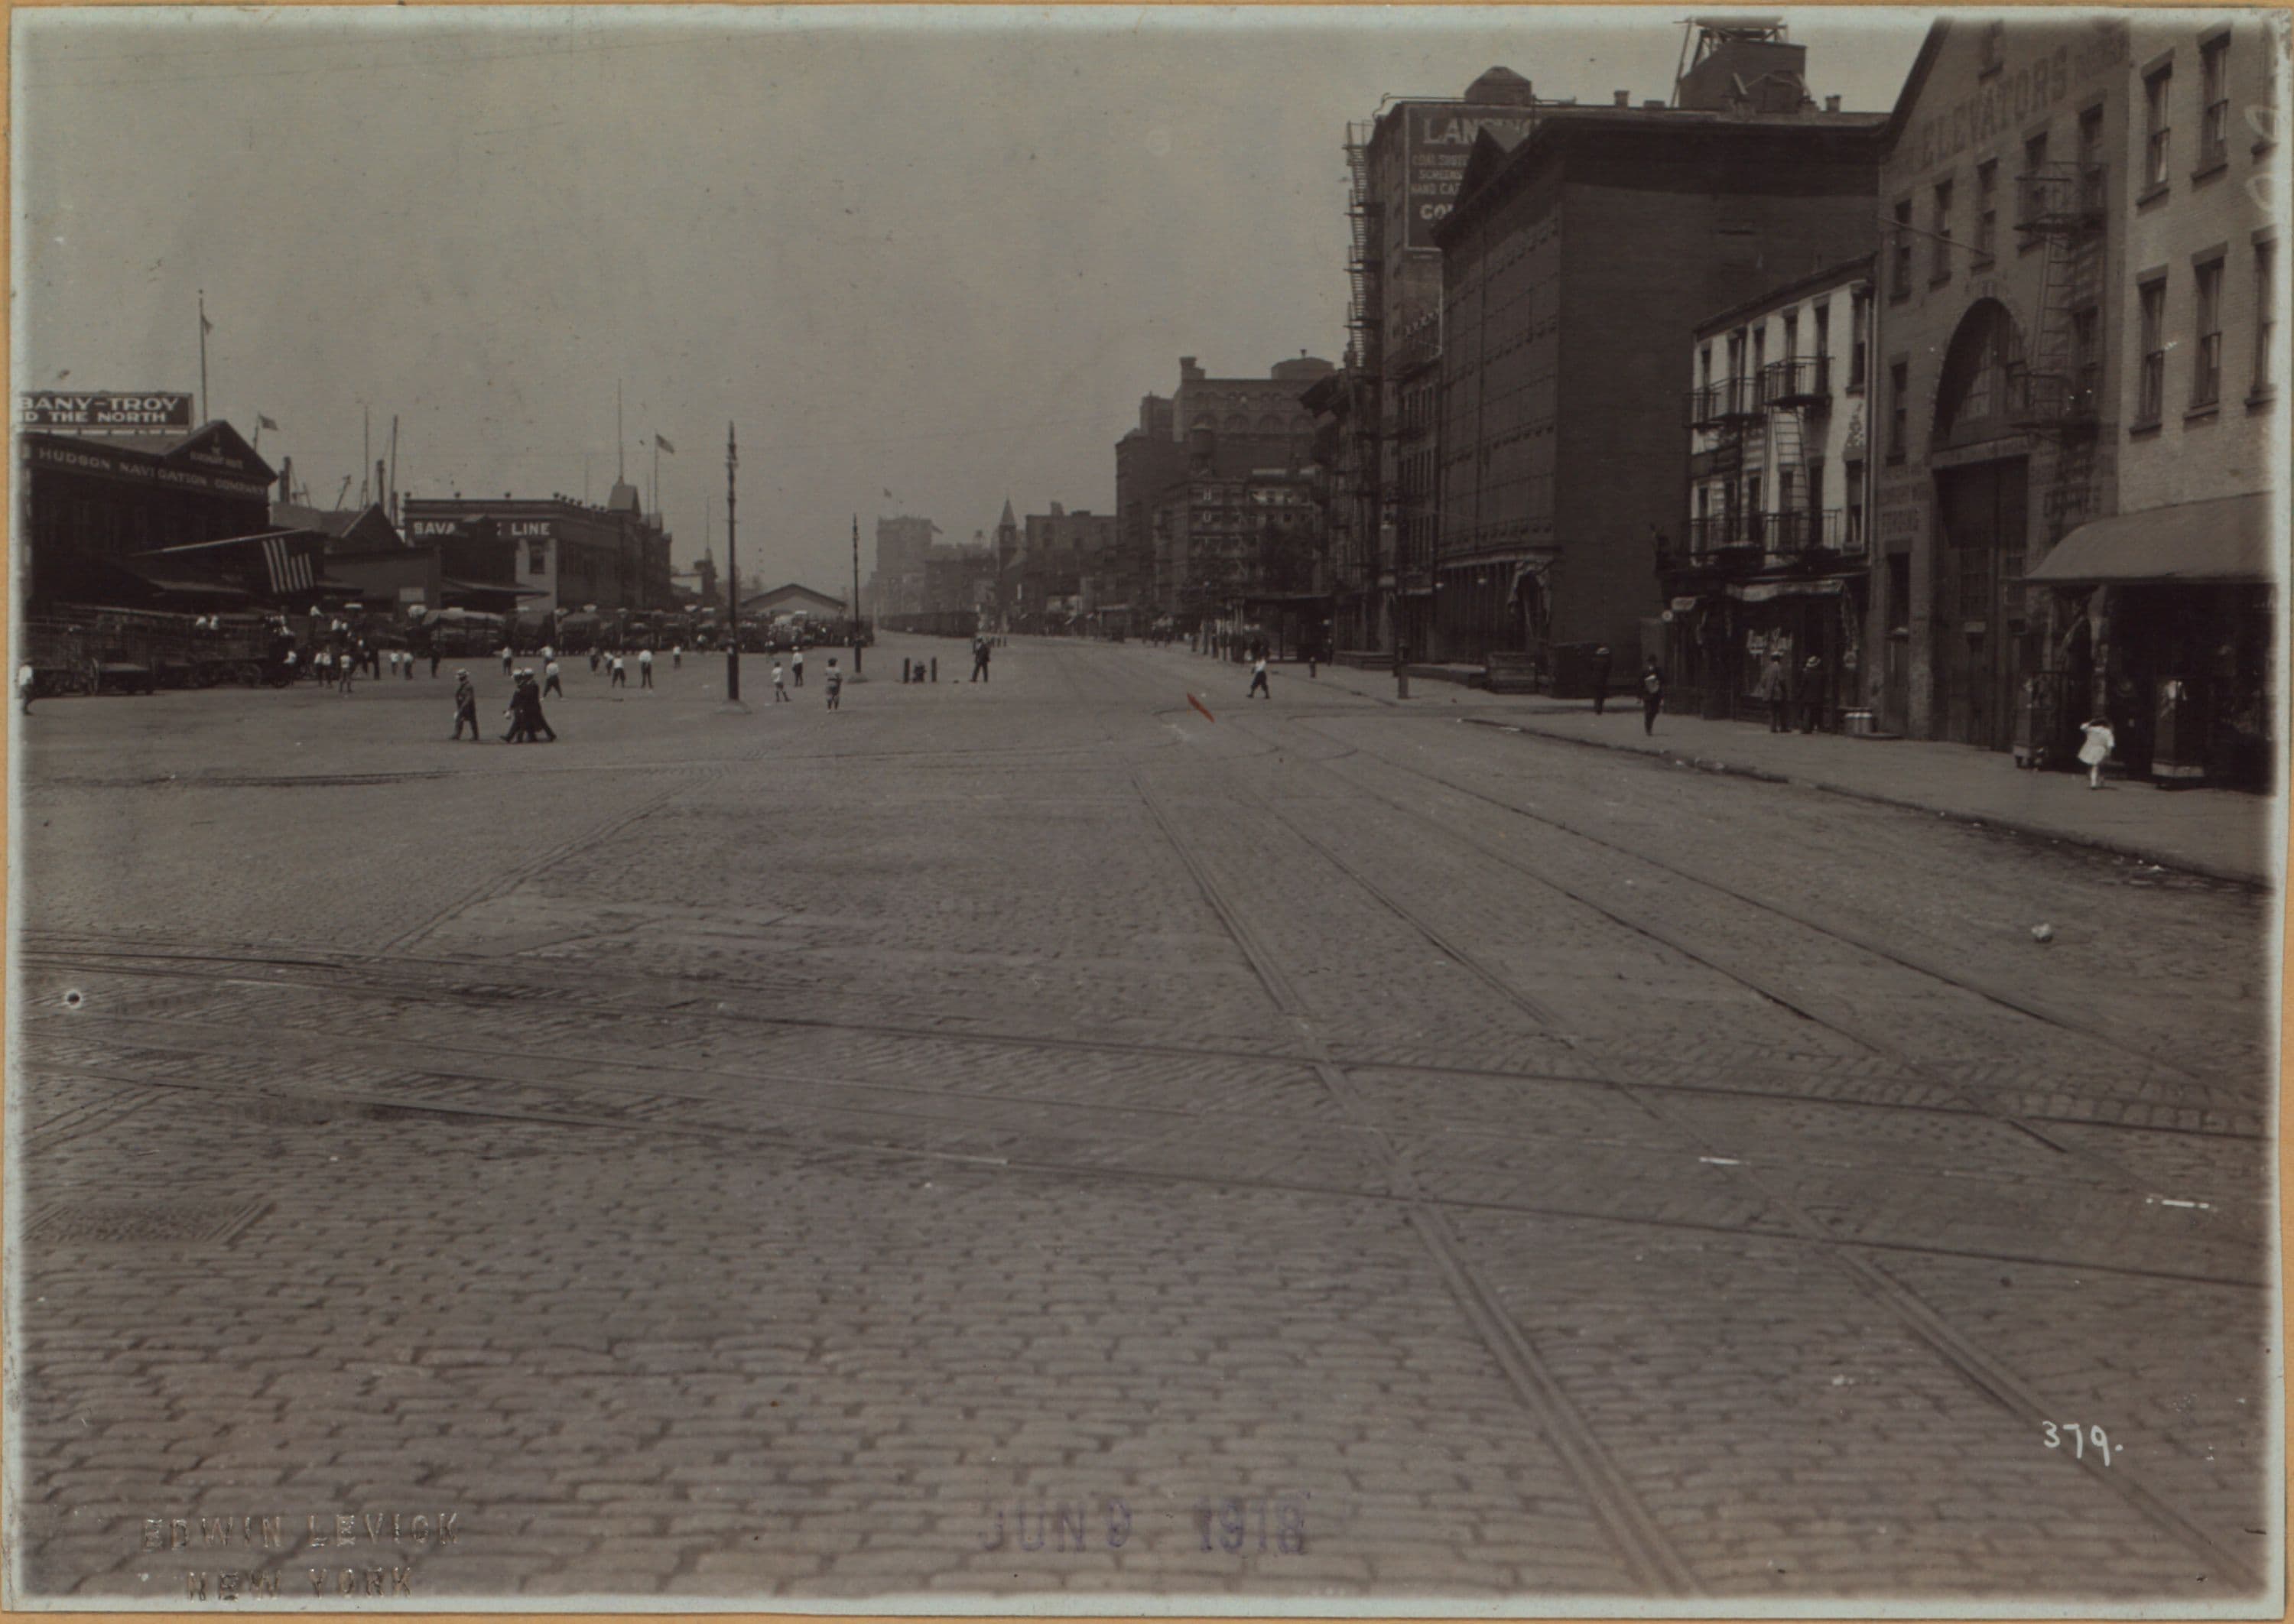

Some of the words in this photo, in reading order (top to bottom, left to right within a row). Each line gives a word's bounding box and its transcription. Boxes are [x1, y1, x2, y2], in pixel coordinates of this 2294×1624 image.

[49, 411, 88, 423] THE
[98, 411, 165, 423] NORTH
[38, 447, 110, 471] HUDSON
[512, 522, 551, 536] LINE
